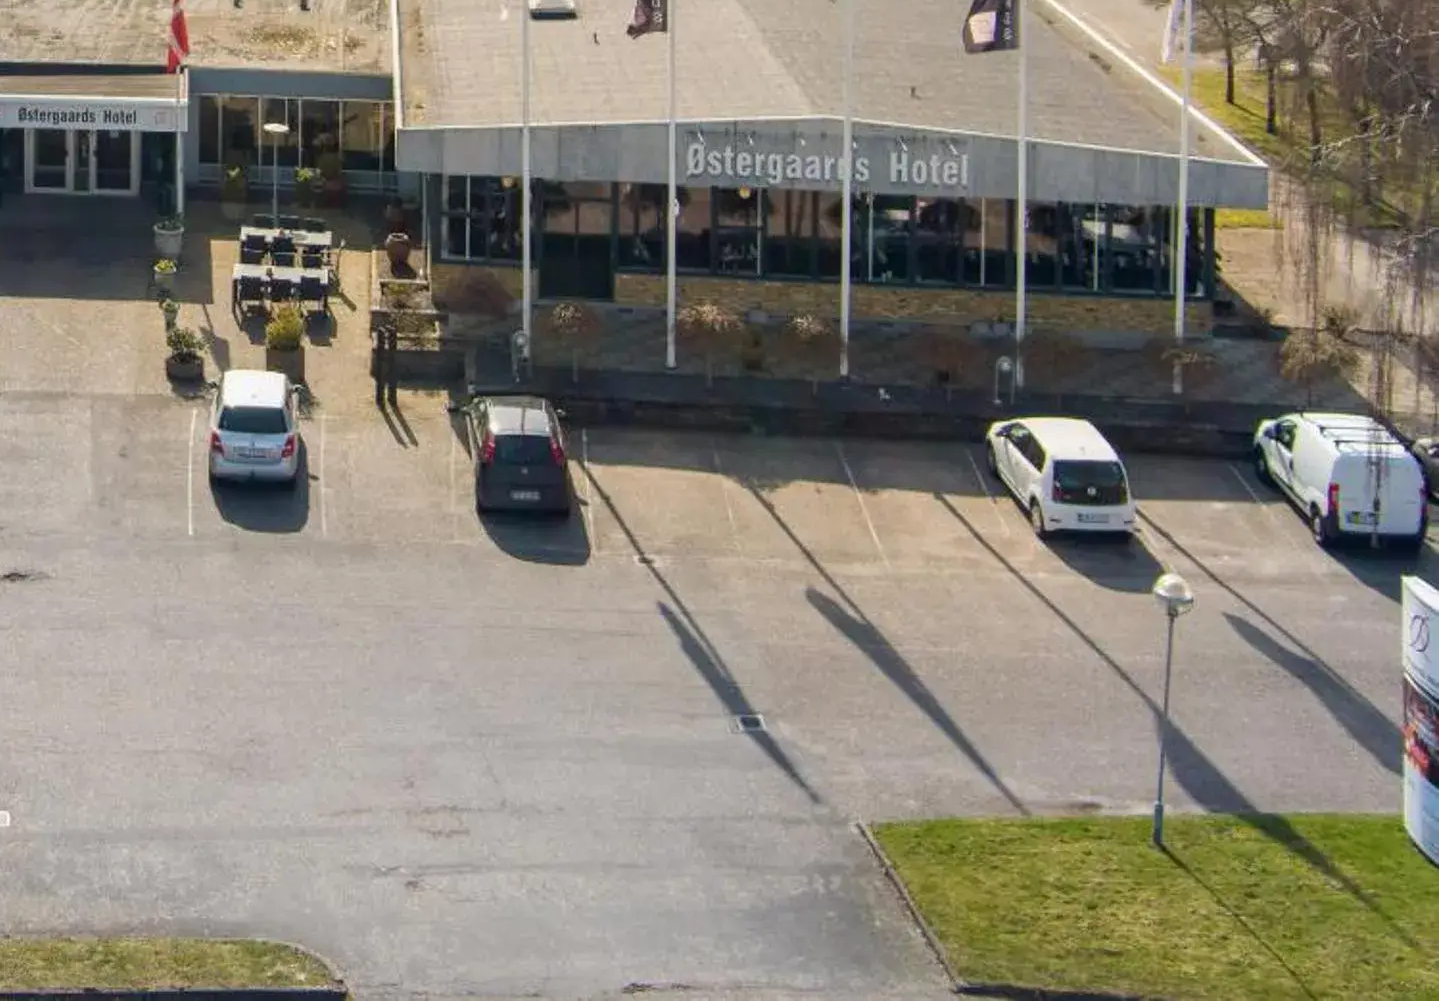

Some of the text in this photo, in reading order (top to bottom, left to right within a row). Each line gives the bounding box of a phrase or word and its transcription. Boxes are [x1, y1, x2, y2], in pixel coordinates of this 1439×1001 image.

[18, 108, 136, 125] Østergaards Hotel
[890, 151, 968, 186] Hotel
